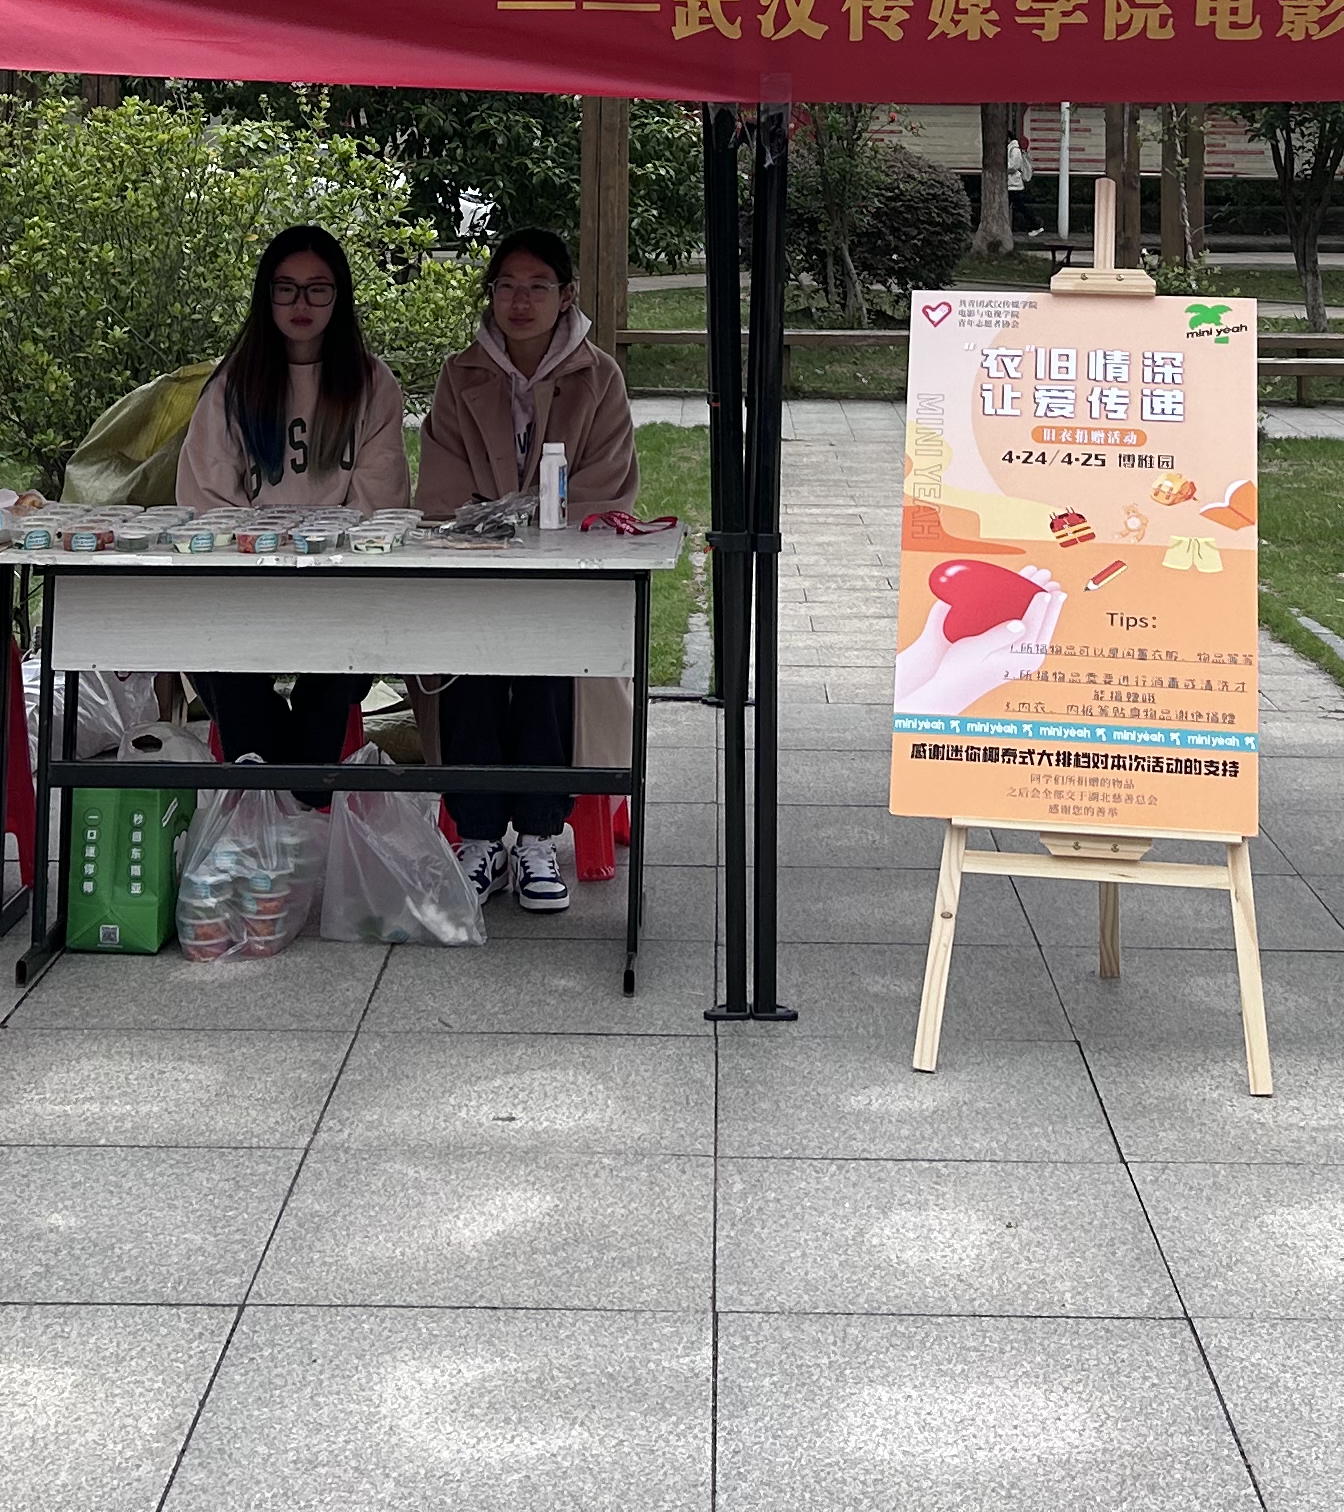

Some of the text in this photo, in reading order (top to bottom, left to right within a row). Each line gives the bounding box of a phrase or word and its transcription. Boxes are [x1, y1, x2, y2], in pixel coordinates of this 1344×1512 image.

[958, 309, 1020, 319] 电影与电视学院
[980, 383, 1185, 423] 让爱传递
[1043, 428, 1138, 445] 旧衣捐赠活动
[911, 392, 945, 540] MINI YEAH
[1118, 453, 1175, 470] 博雅园
[1106, 611, 1157, 631] Tips:
[910, 743, 1240, 777] 感谢迷你椰泰式大排档对本次活动的支持
[1029, 773, 1135, 789] 同学们所捐赠的物品
[1048, 804, 1119, 818] 感谢您的善举
